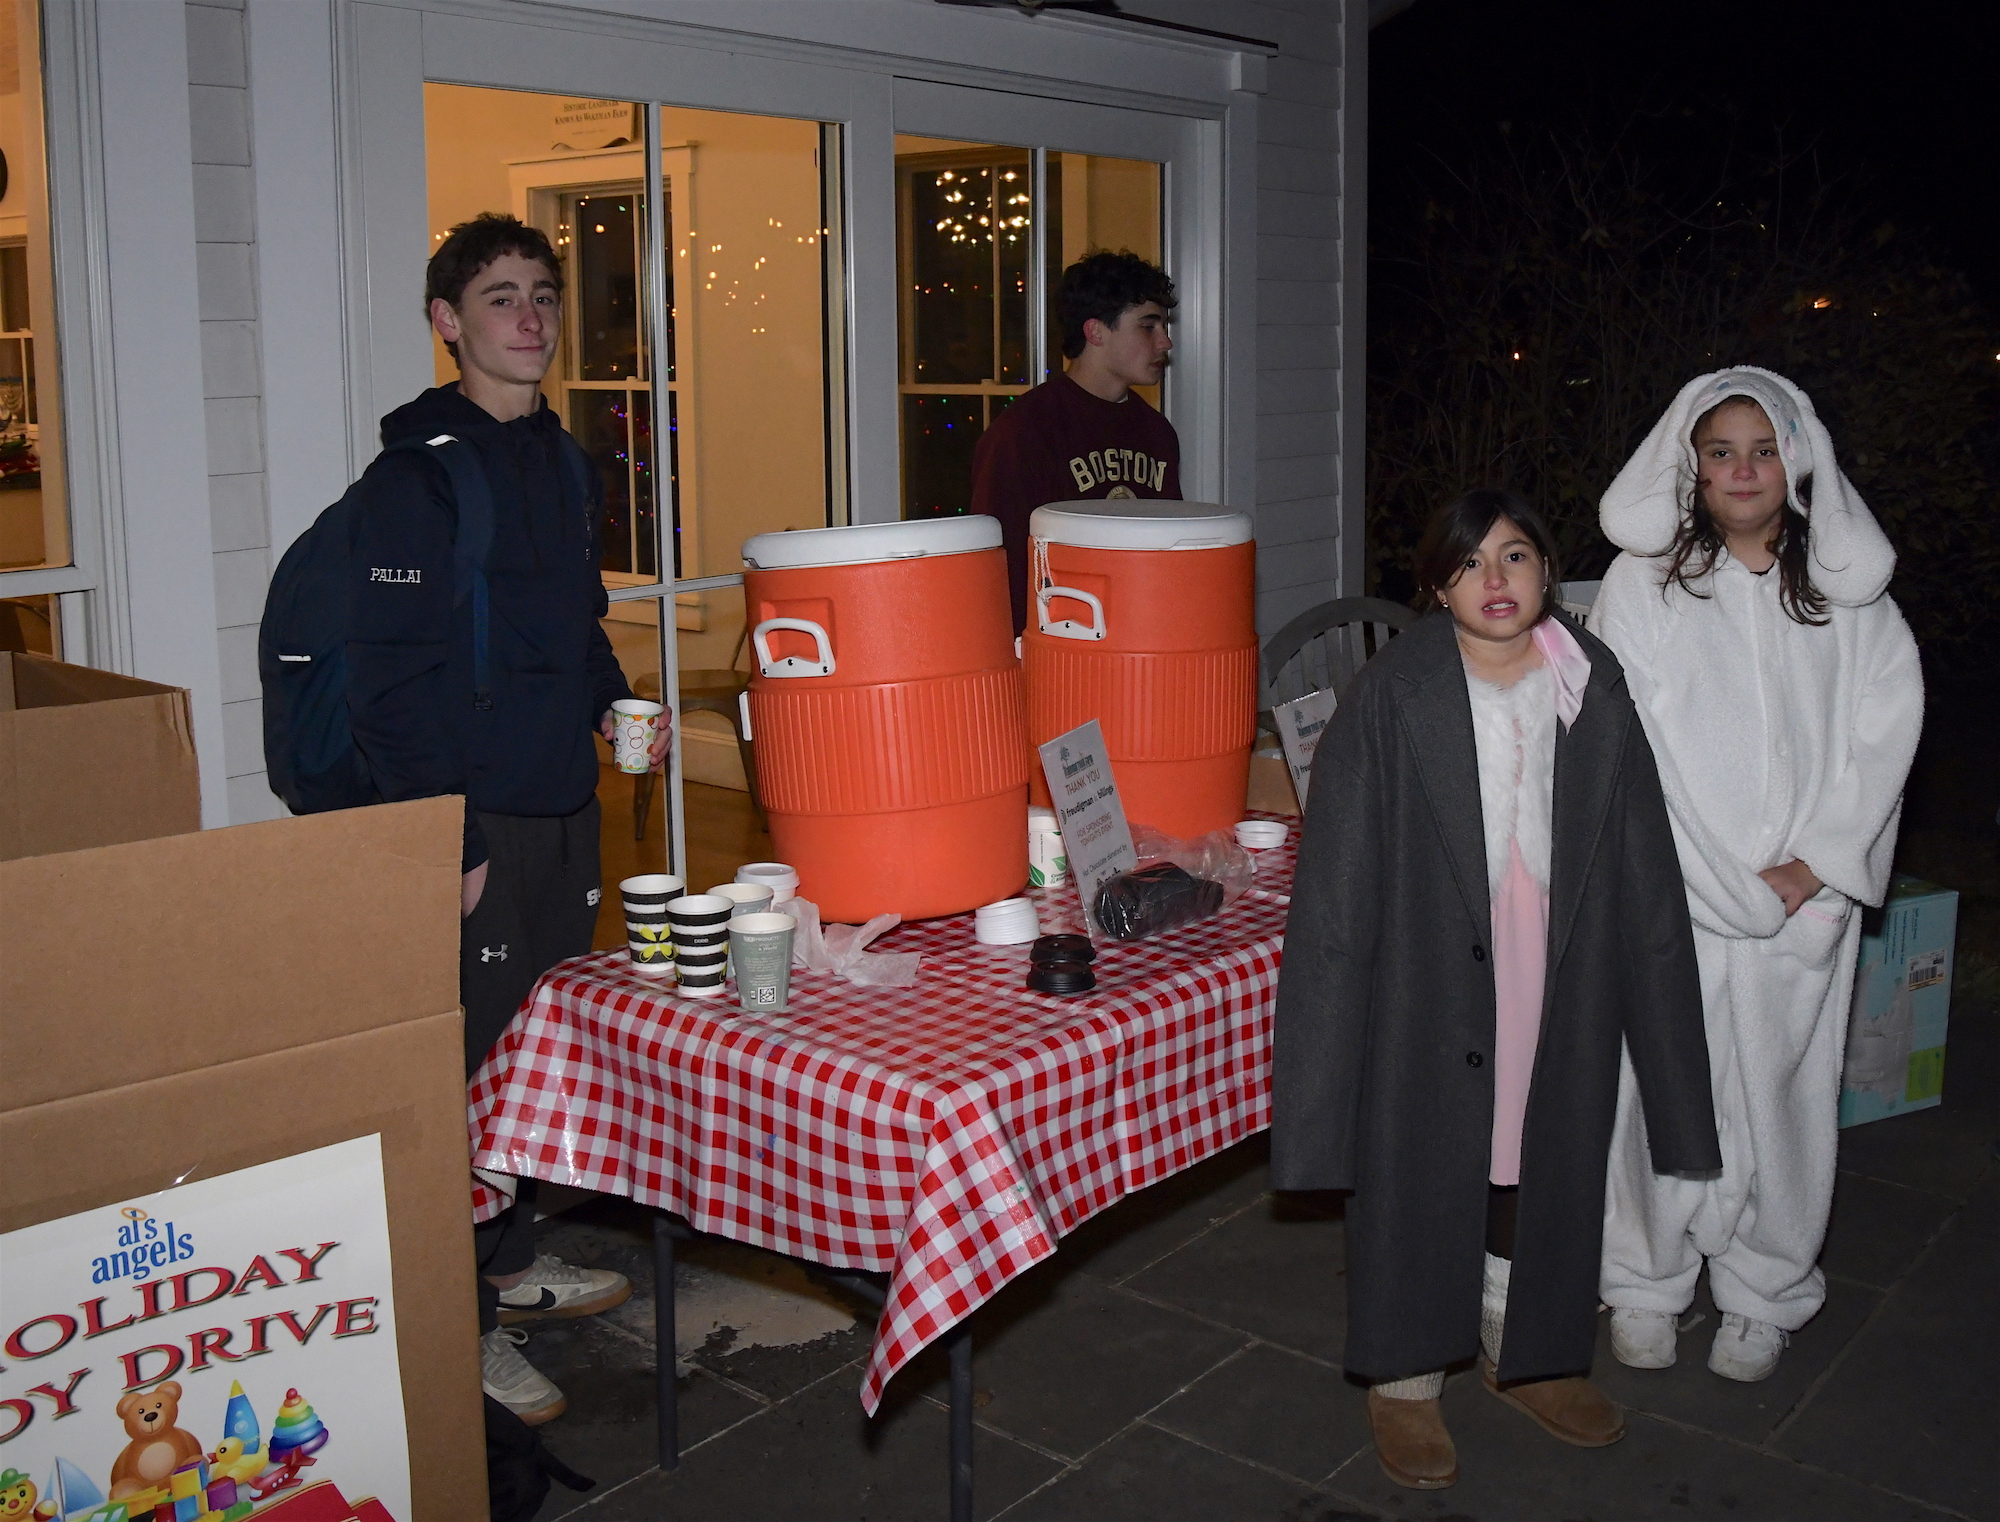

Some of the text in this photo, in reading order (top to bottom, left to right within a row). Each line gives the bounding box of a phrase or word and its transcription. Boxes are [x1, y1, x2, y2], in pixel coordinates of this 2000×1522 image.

[1069, 448, 1167, 493] BOSTON
[370, 568, 421, 583] PALLAI
[1065, 768, 1100, 796] THANK YOU
[1066, 797, 1094, 818] freudigman
[1097, 785, 1114, 799] billings
[91, 1221, 195, 1285] angels
[0, 1241, 341, 1373] OLIDAY
[117, 1296, 380, 1392] DRIVE
